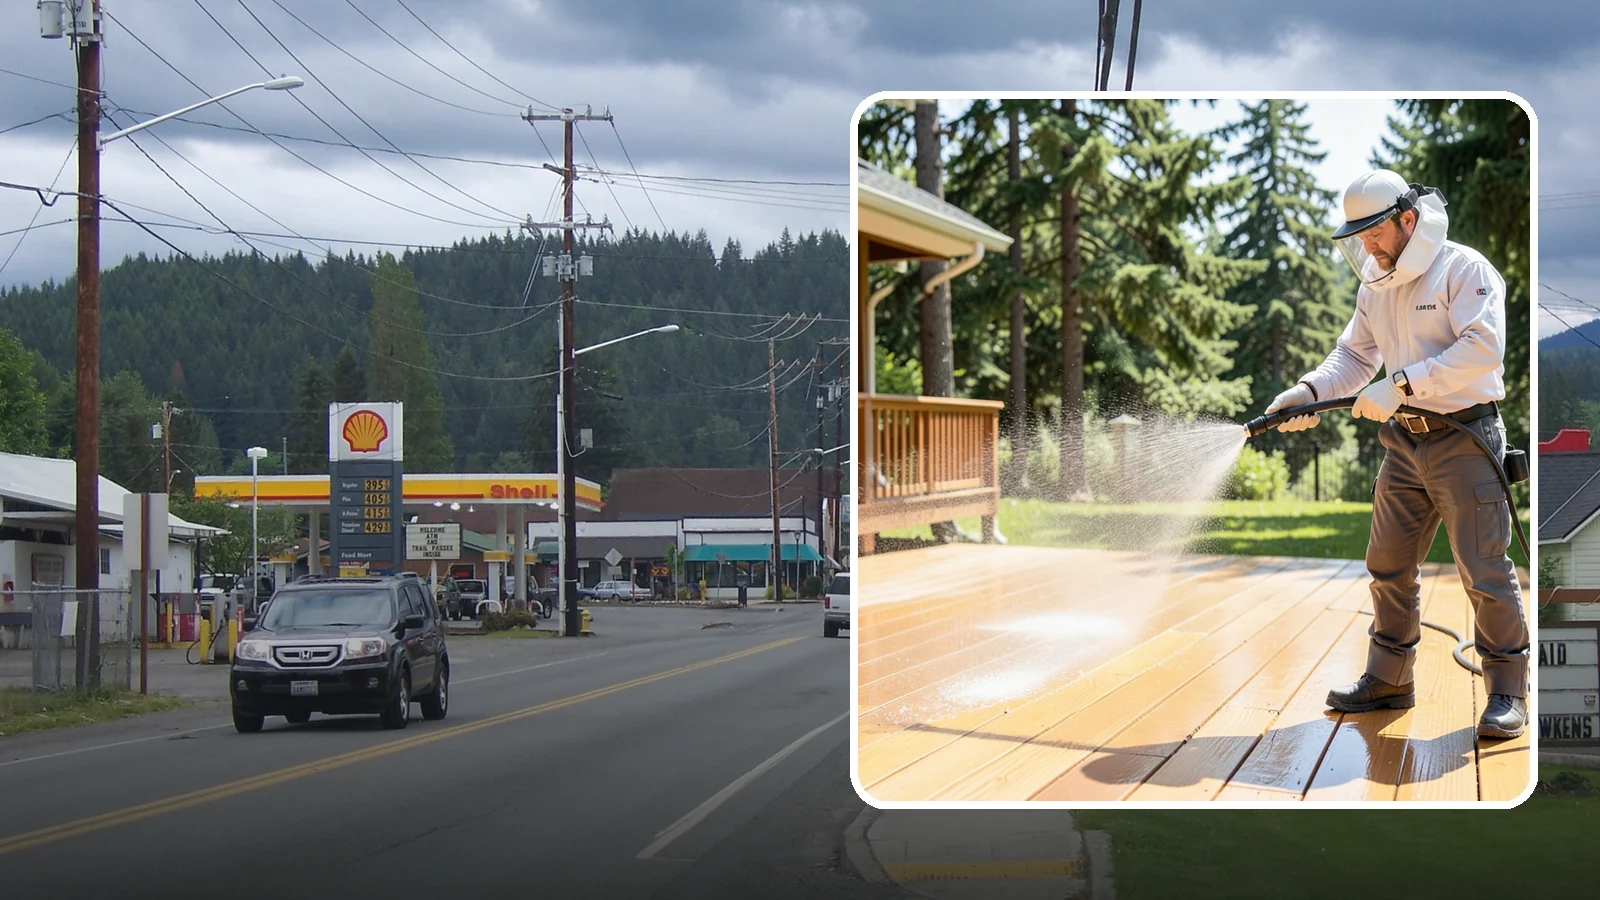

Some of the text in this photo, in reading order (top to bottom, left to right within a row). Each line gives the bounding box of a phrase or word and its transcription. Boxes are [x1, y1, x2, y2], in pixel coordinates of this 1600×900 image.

[365, 480, 383, 490] 395
[490, 484, 548, 499] Shell
[365, 494, 383, 504] 405
[365, 508, 383, 518] 415
[365, 522, 383, 532] 429
